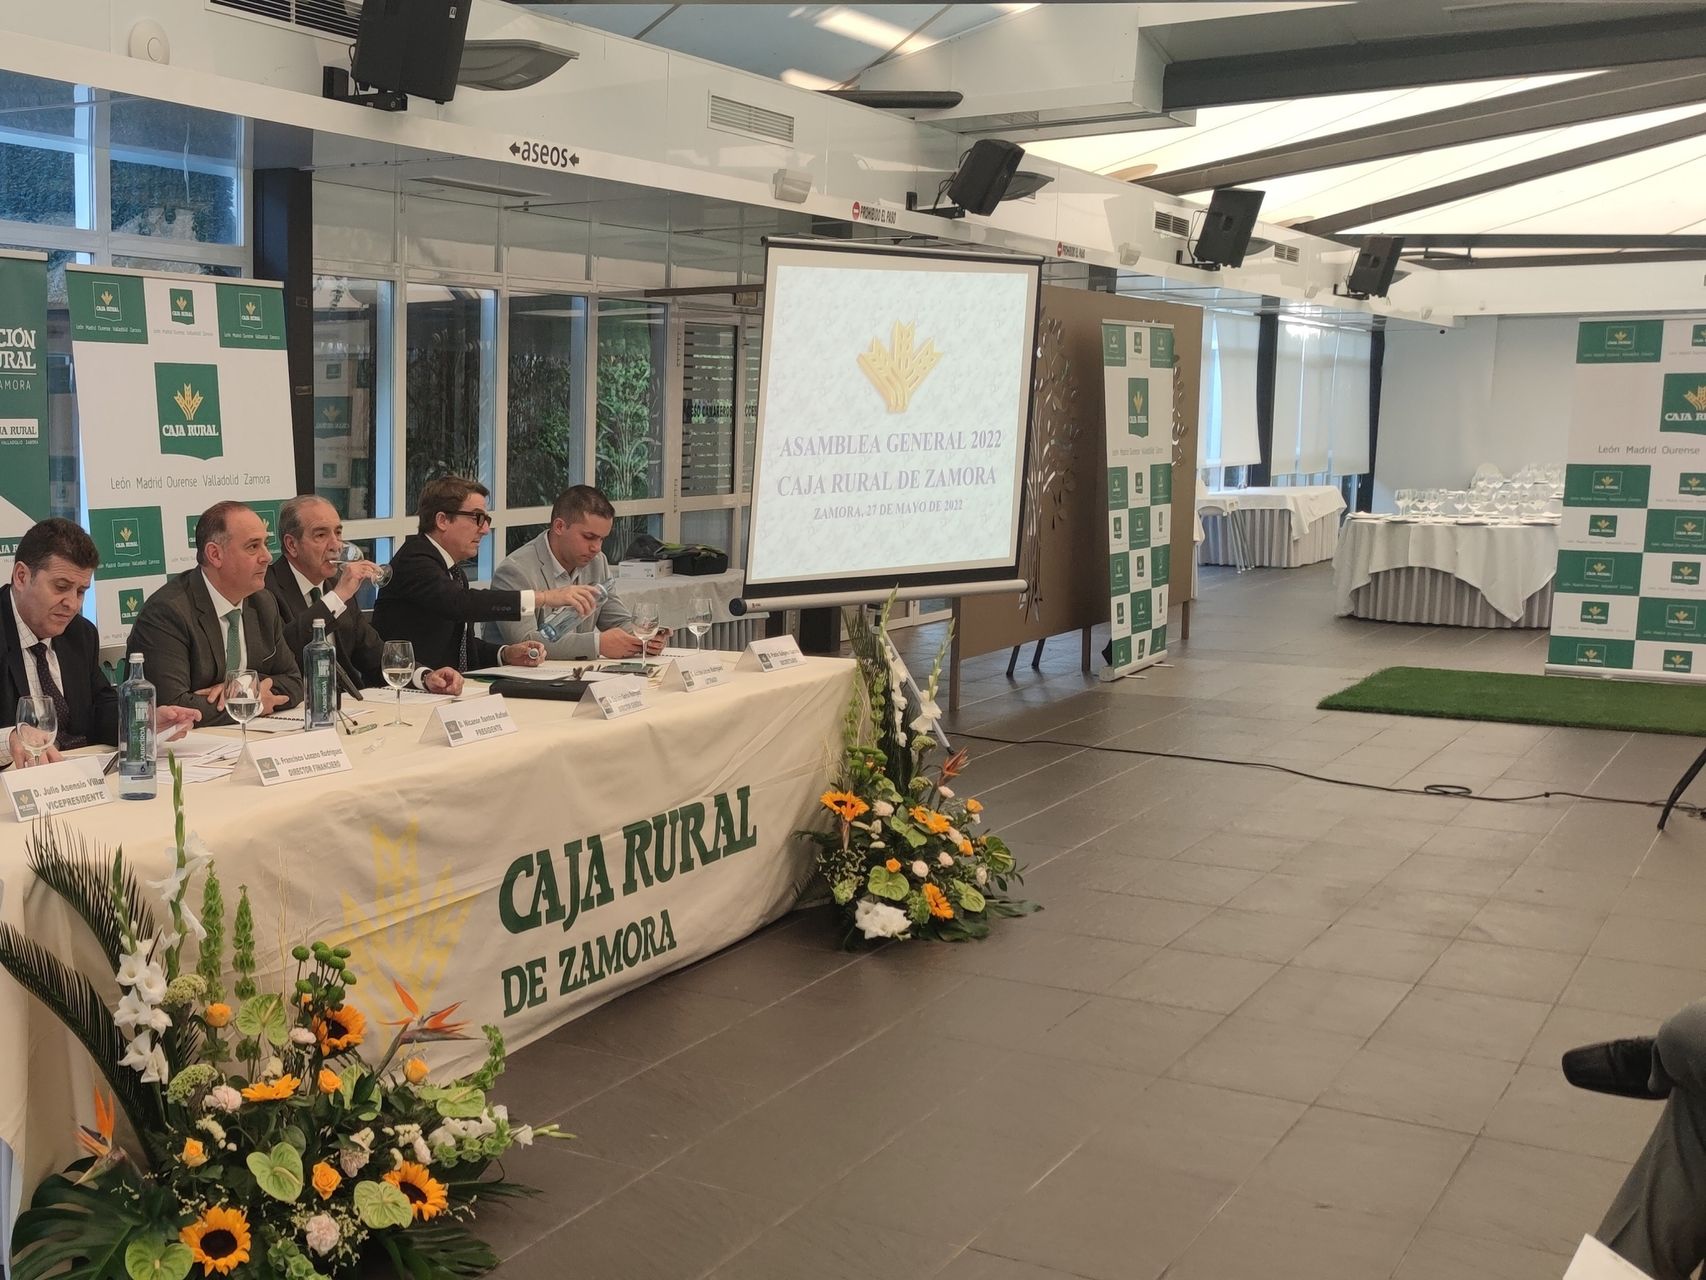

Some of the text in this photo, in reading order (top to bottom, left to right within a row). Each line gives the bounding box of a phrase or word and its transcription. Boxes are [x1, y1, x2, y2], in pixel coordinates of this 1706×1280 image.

[521, 141, 568, 168] aseos
[1665, 412, 1693, 422] CAJA
[10, 426, 37, 435] RURAL
[162, 424, 219, 437] CAJA RURAL
[779, 430, 1002, 457] ASAMBLEA GENERAL 2022
[1598, 445, 1701, 455] León Madrid Ourense
[110, 474, 271, 490] León Madrid Ourense Valladolid Zamora
[777, 466, 997, 497] CAJA RURAL DE ZAMORA
[814, 500, 963, 520] ZAMORA, 27 DE MAYO DE 2022
[475, 723, 503, 736] PRESIDENTE
[274, 758, 281, 766] D.
[281, 755, 304, 764] Francisco
[303, 752, 320, 760] Lozano
[288, 760, 341, 776] DIRECTOR FINANCIERO
[33, 777, 105, 798] D. Julio Asensio Villar
[45, 791, 105, 810] VICEPRESIDENTE
[499, 785, 757, 934] CAJA RURAL
[501, 909, 677, 1018] DE ZAMORA
